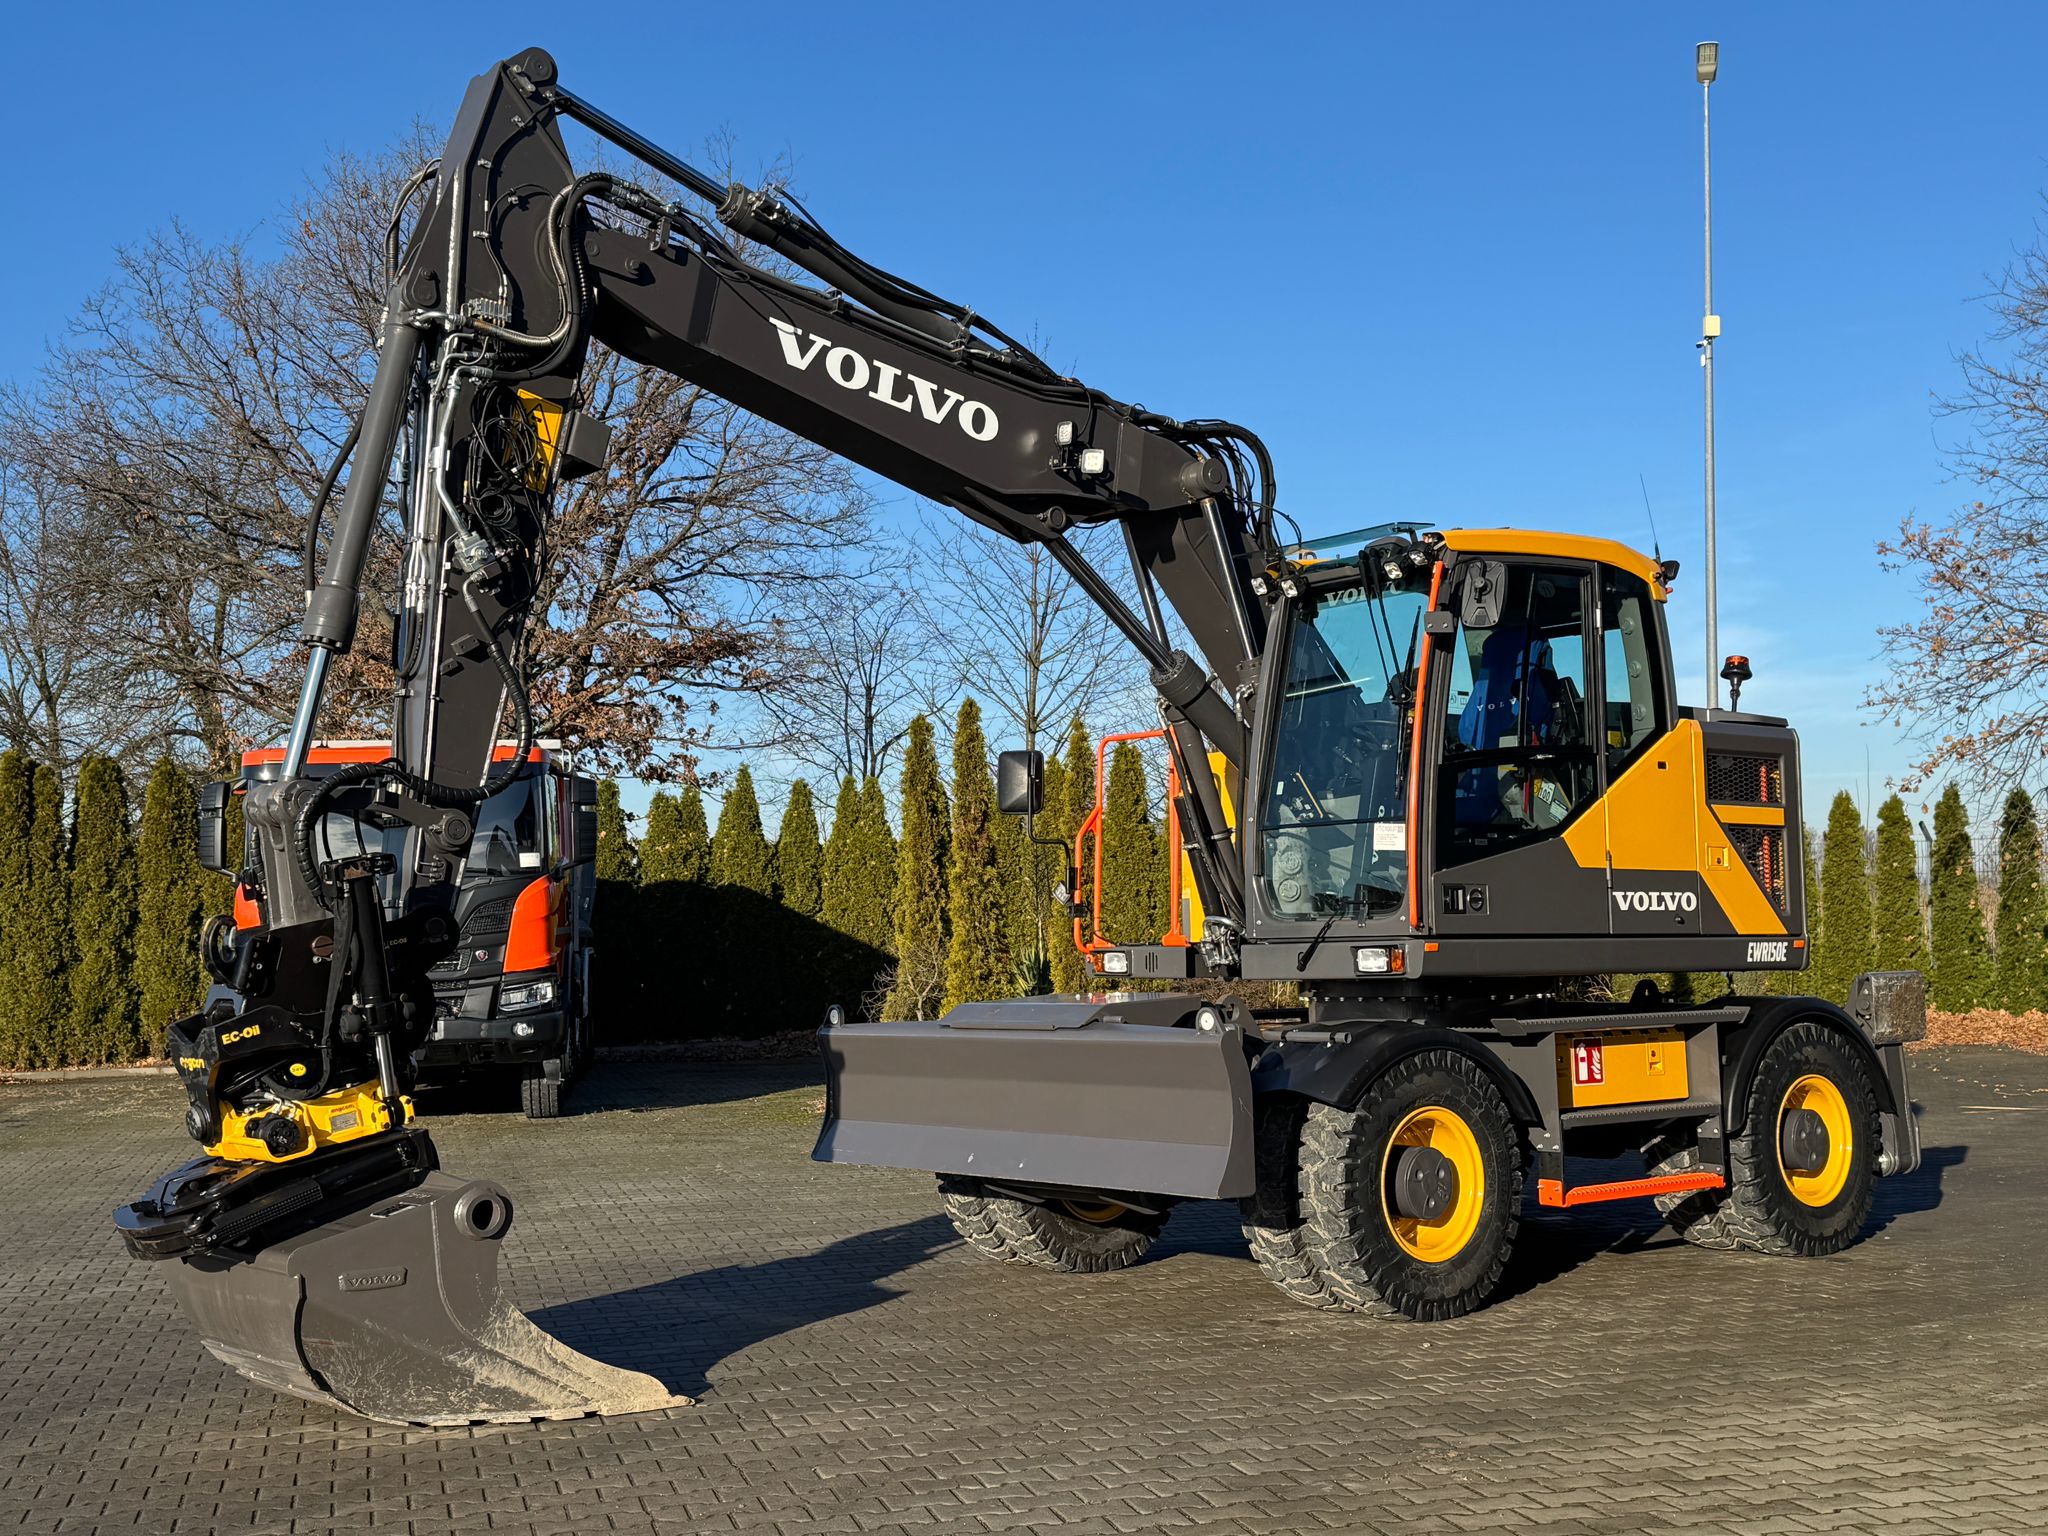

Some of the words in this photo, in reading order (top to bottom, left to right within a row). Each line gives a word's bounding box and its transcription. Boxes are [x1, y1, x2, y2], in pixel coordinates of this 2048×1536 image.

[769, 316, 1000, 442] VOLVO
[1612, 891, 1697, 912] VOLVO
[1747, 941, 1788, 963] EWR150E
[221, 1024, 261, 1045] EC-Oil
[347, 1273, 401, 1288] VOLVO
